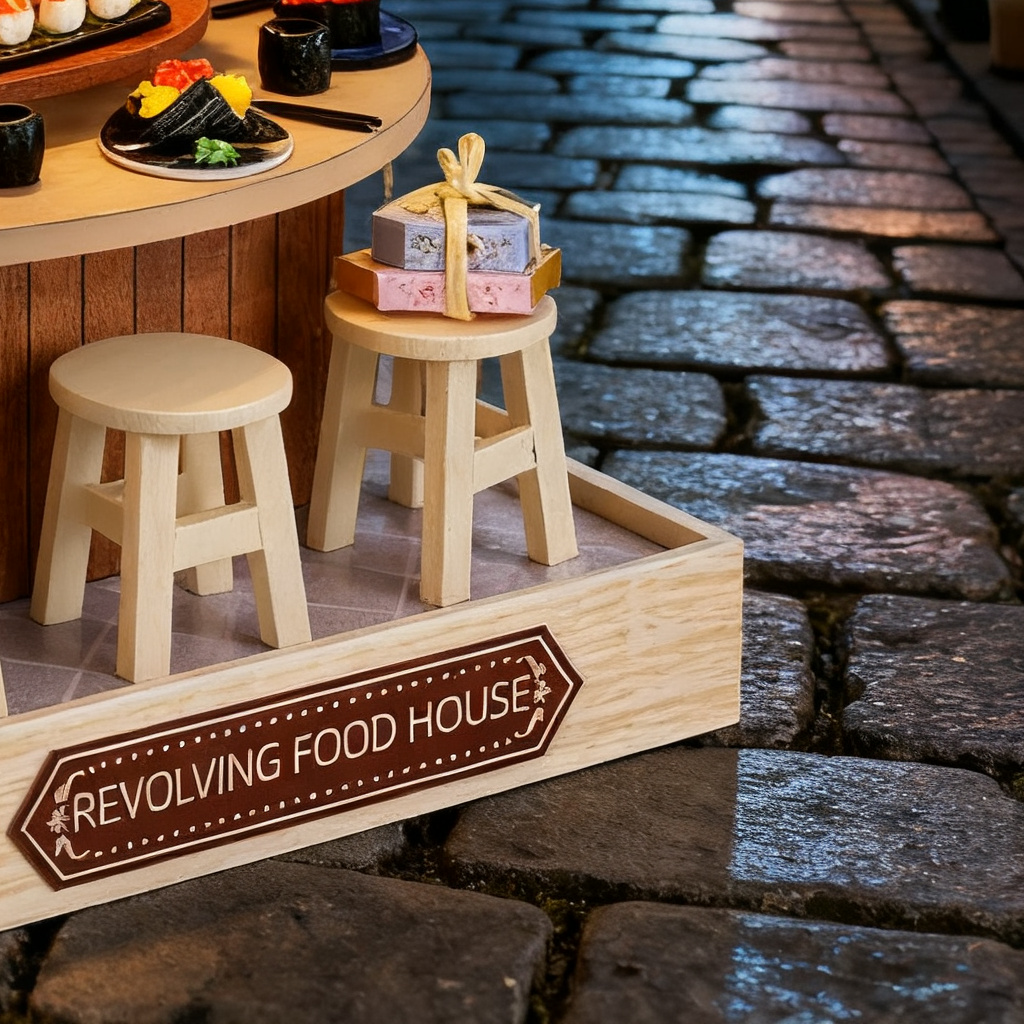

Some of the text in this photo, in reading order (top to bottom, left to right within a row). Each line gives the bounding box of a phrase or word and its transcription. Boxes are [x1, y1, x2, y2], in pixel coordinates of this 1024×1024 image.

[74, 674, 531, 833] REVOLVING FOOD HOUSE
